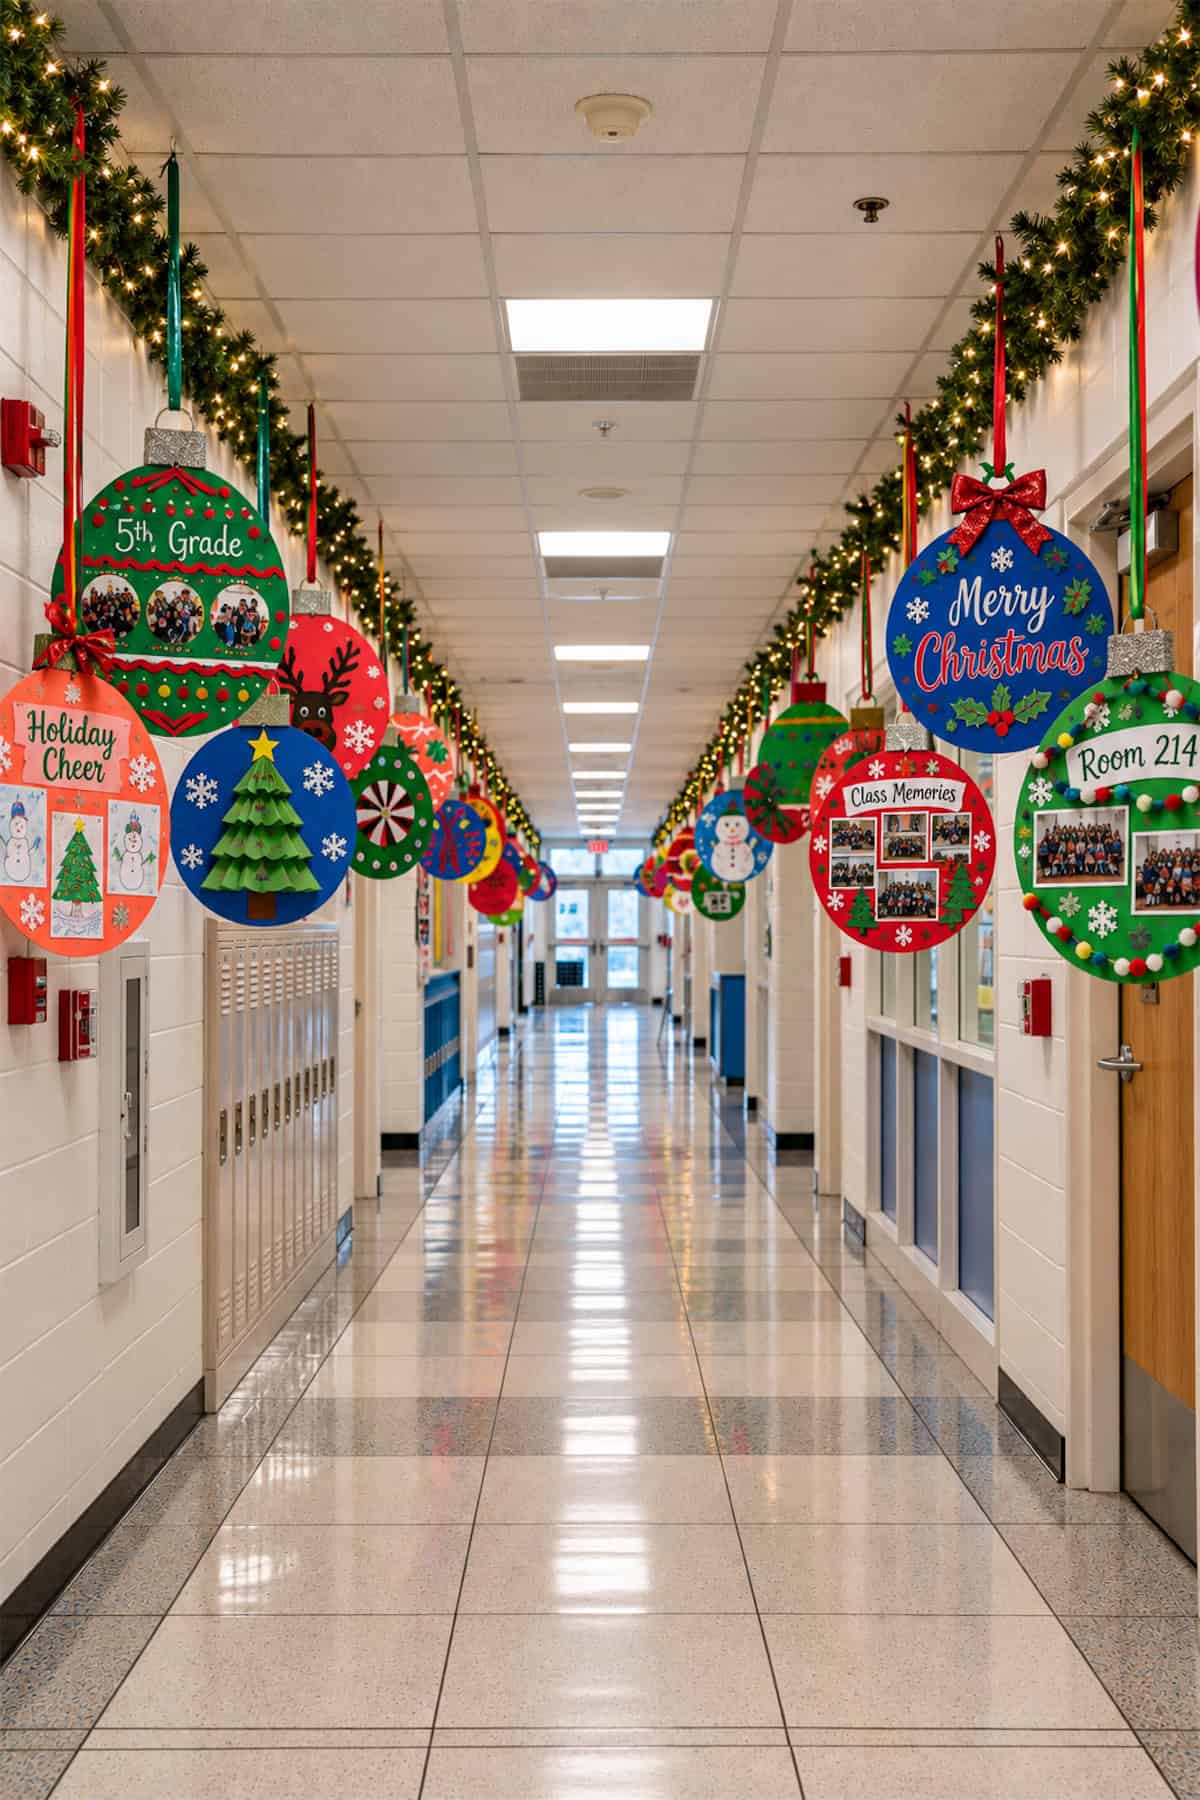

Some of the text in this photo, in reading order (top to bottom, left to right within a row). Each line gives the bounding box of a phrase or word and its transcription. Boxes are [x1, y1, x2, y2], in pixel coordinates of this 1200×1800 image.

[115, 518, 243, 561] 5th Grade
[949, 575, 1055, 633] Merry
[914, 628, 1089, 692] Christmas
[27, 709, 116, 760] Holiday
[1078, 734, 1197, 781] Room 214
[43, 747, 105, 783] Cheer
[851, 781, 956, 807] Class Memories
